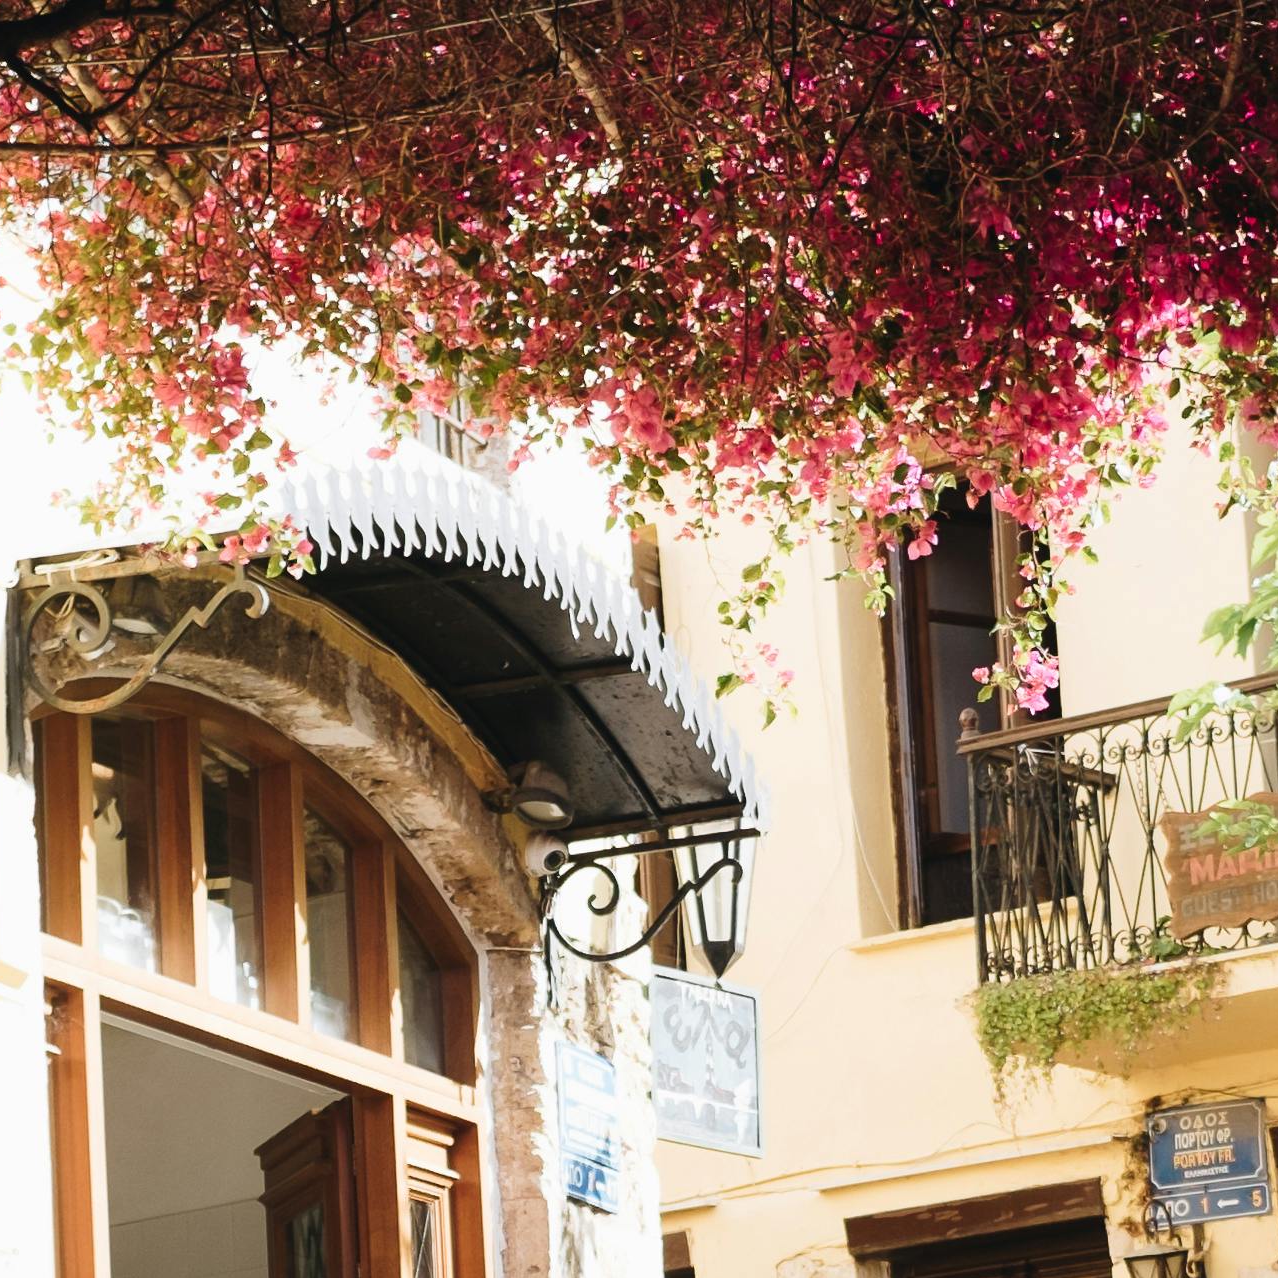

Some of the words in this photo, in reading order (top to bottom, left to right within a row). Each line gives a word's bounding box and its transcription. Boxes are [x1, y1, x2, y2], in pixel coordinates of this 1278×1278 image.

[1182, 889, 1241, 918] GUEST
[1179, 1111, 1228, 1130] ΟΔΟΣ
[1201, 1197, 1209, 1215] 1
[1251, 1189, 1262, 1208] 5
